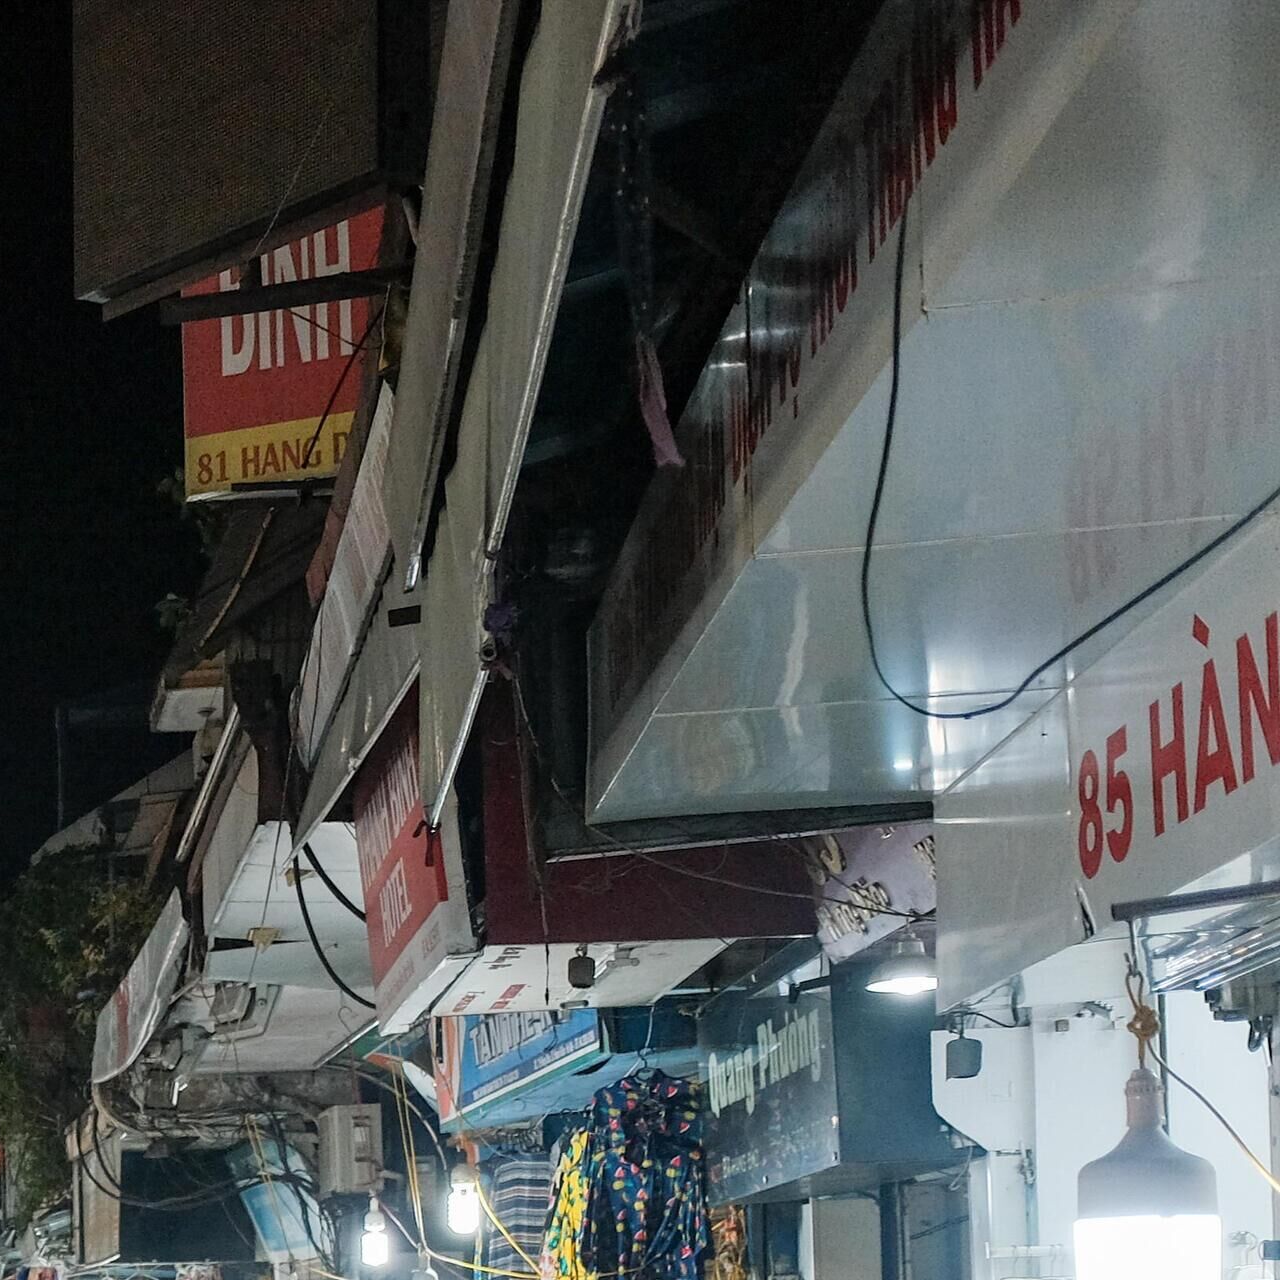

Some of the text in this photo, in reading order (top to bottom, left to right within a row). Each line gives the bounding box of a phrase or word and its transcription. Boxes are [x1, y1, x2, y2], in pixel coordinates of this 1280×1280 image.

[197, 450, 230, 486] 81
[241, 435, 322, 480] HANG
[1078, 724, 1133, 879] 85
[379, 857, 413, 948] HOTEL
